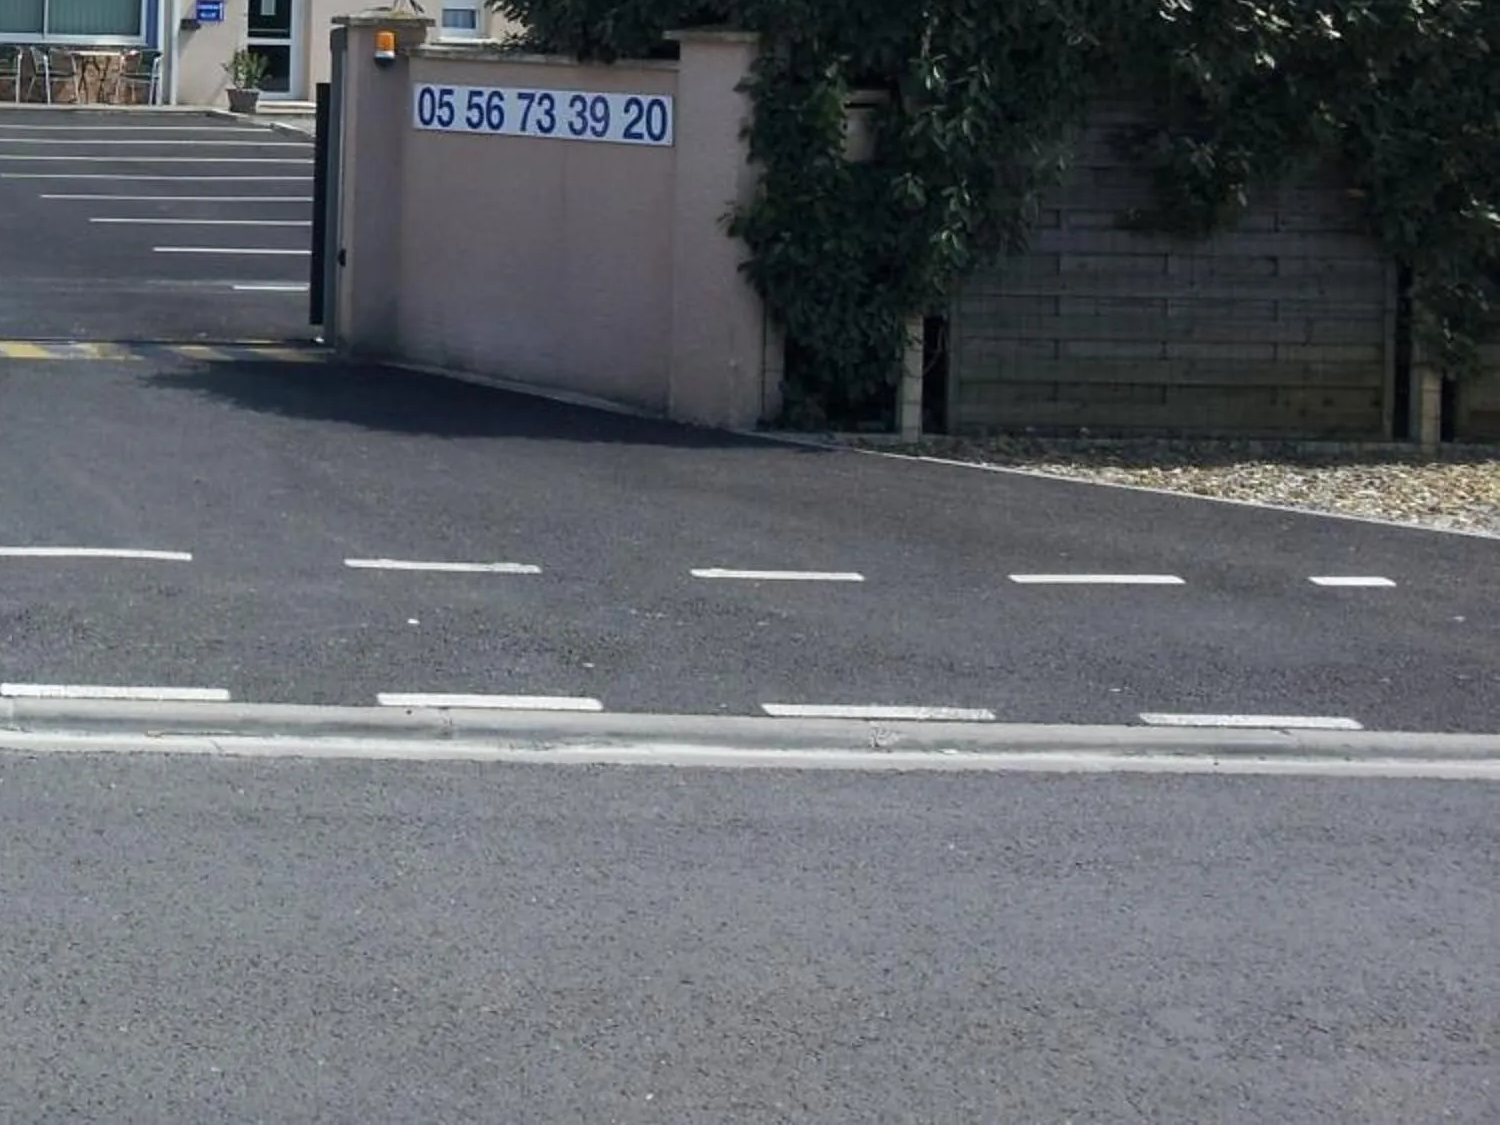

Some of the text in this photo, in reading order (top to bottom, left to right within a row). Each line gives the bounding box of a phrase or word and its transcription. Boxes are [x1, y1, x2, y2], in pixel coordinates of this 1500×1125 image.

[417, 86, 668, 142] 05 56 73 39 20
